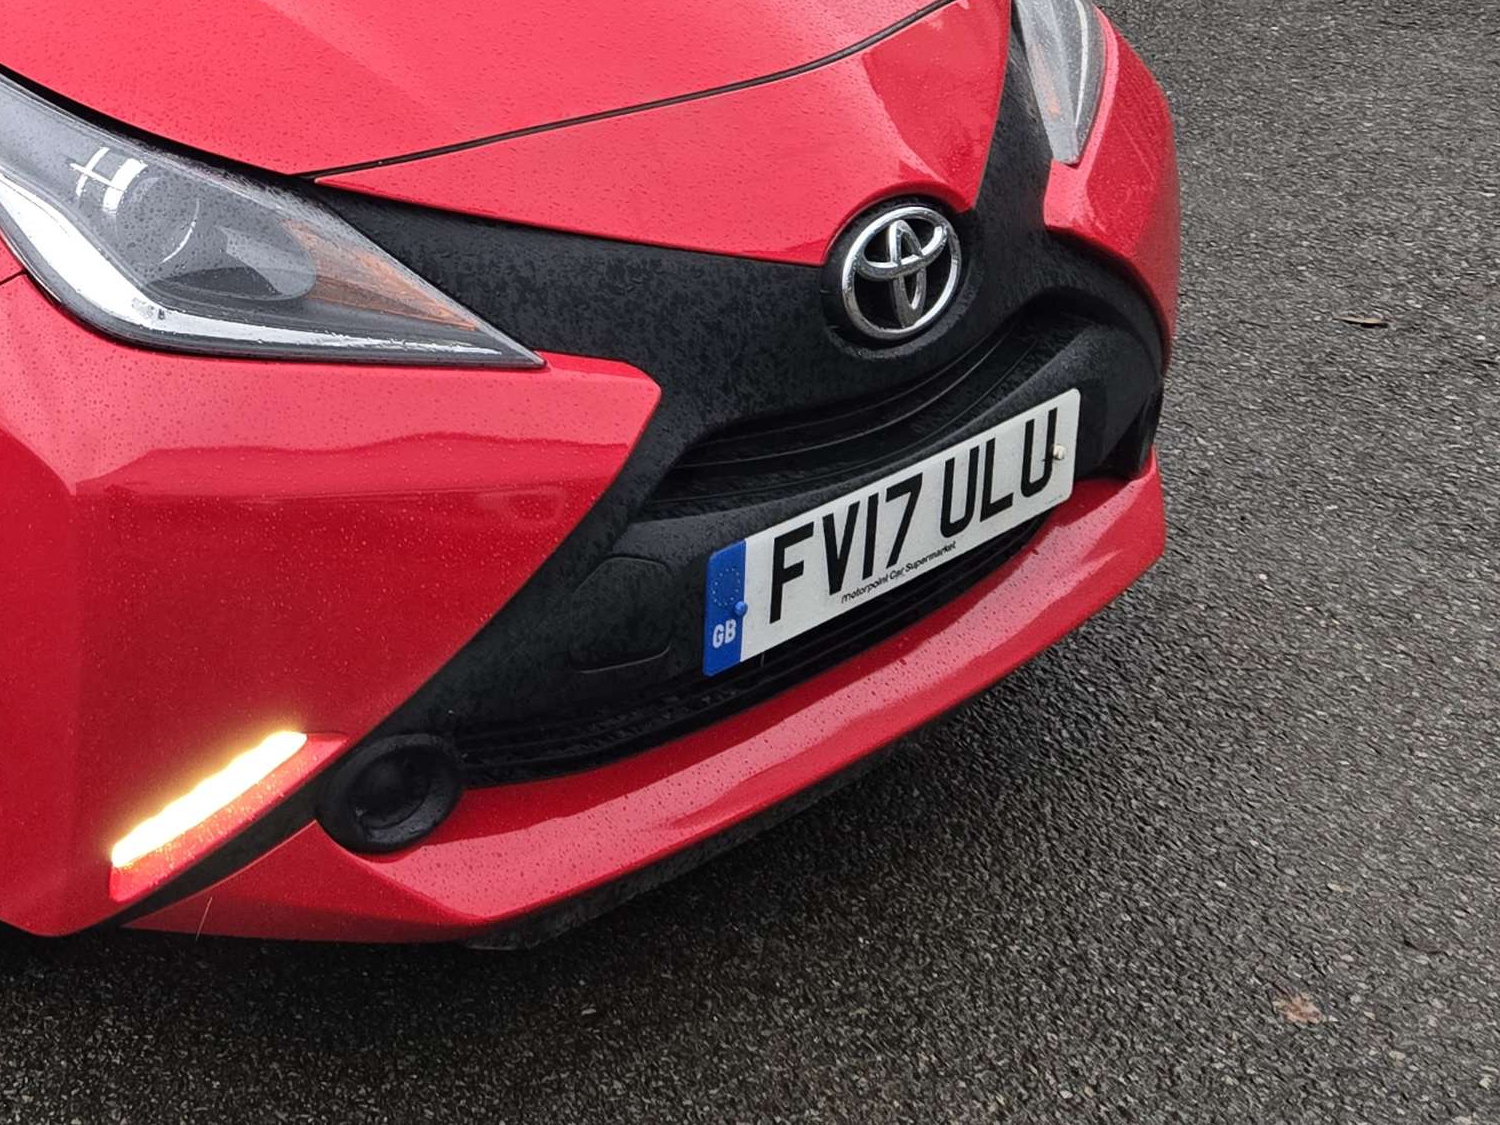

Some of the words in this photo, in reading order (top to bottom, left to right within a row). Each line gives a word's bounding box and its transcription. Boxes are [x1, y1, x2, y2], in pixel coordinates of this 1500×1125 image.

[769, 472, 923, 624] FV17
[940, 407, 1058, 538] ULU
[889, 565, 905, 580] Car
[905, 540, 957, 573] Supermarket
[712, 618, 737, 649] GB
